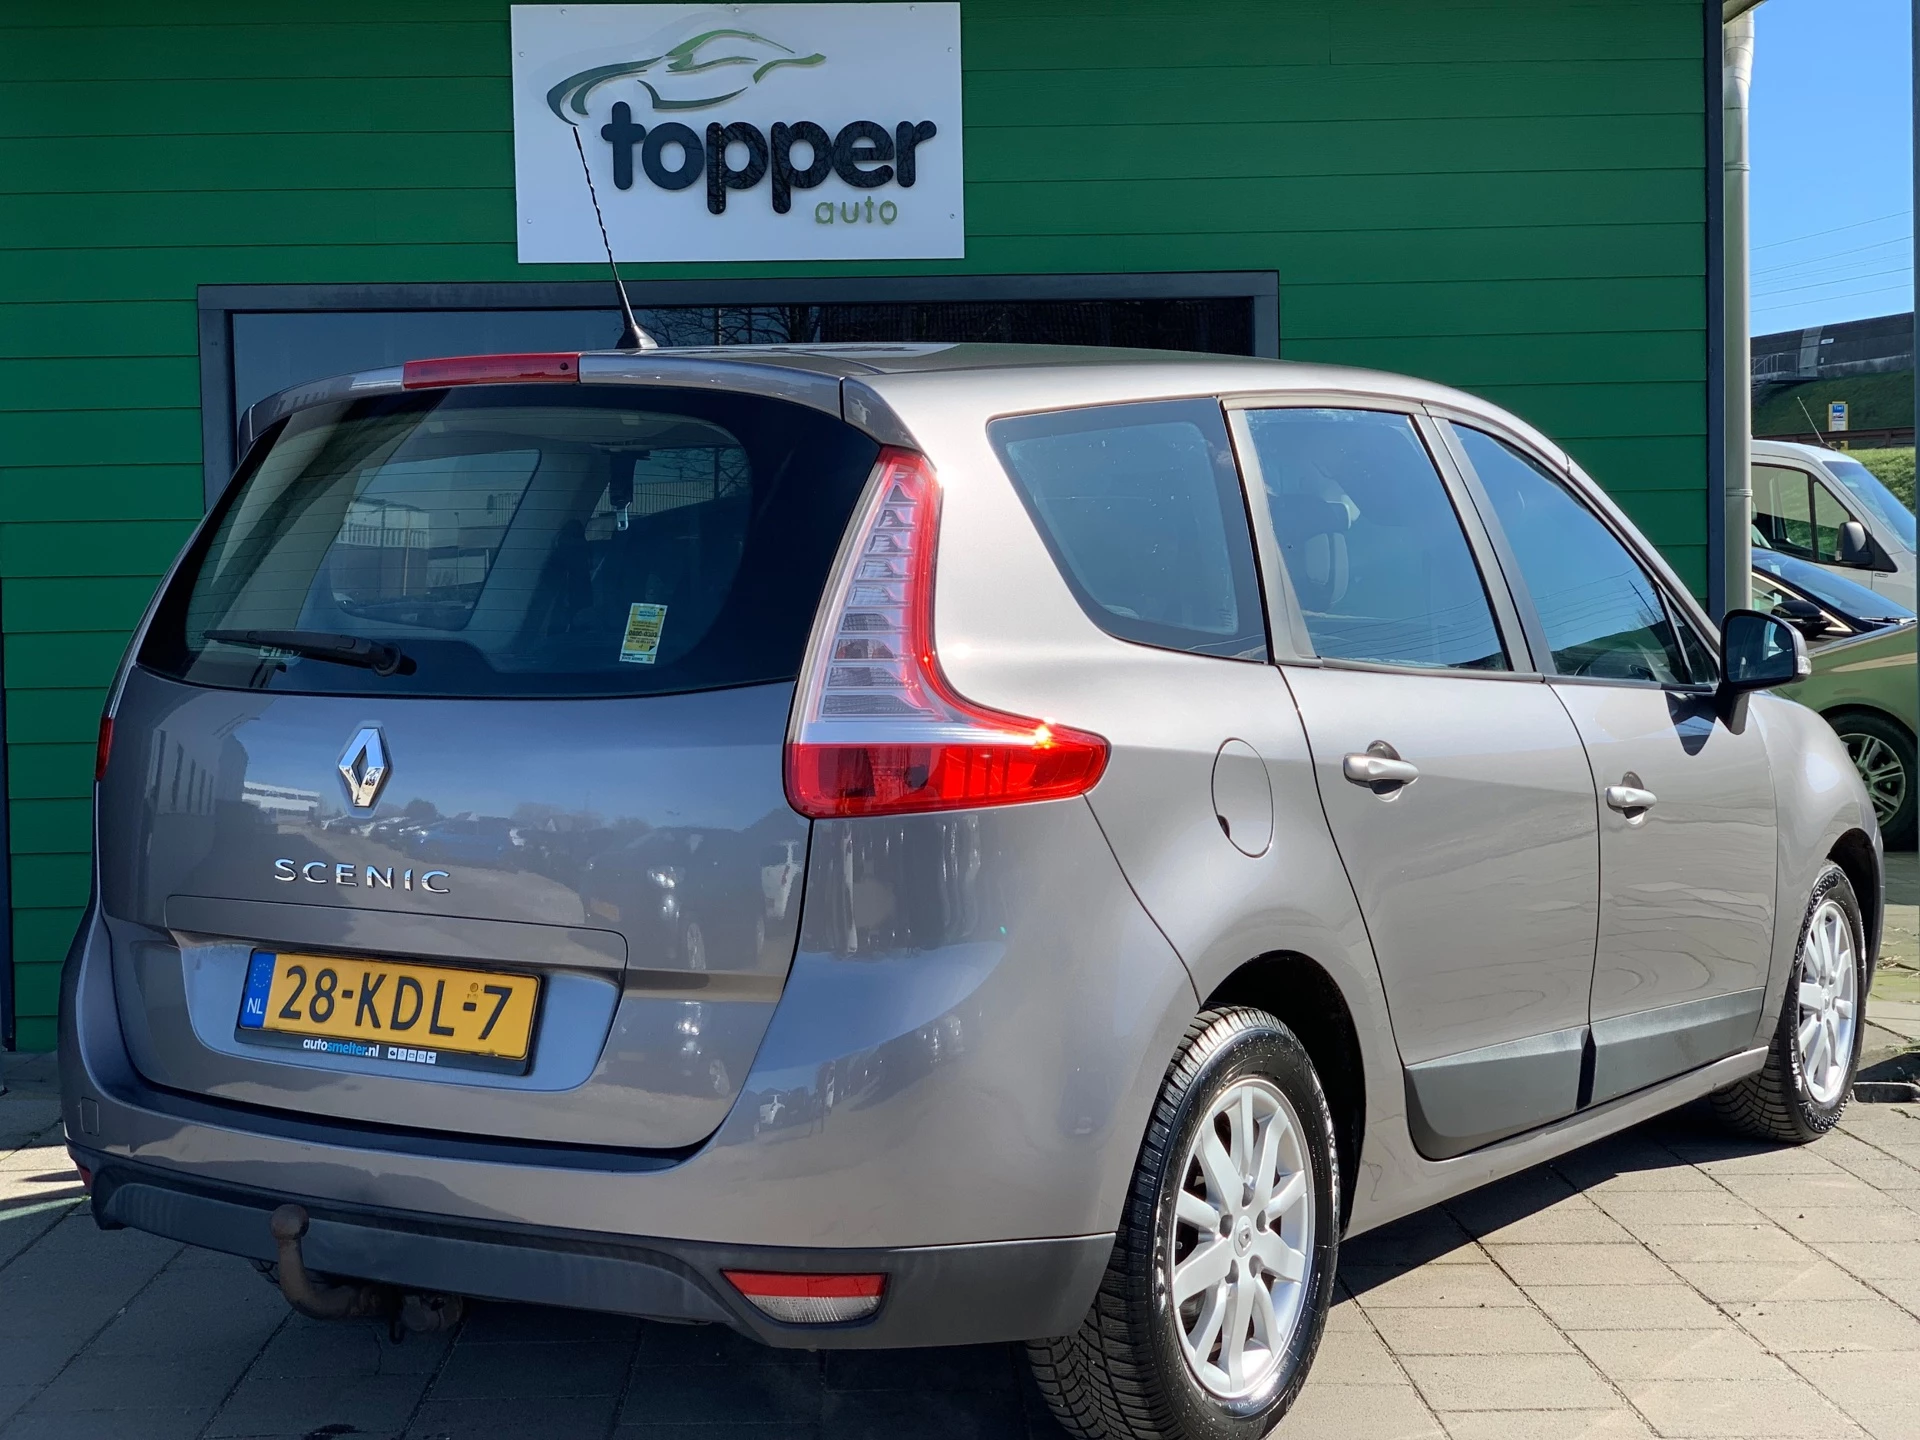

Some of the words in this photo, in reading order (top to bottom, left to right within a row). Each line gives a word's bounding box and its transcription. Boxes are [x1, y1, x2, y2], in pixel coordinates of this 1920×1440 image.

[600, 101, 937, 215] topper
[814, 195, 898, 225] auto
[274, 858, 450, 894] SCENIC
[246, 997, 263, 1015] NL
[279, 965, 513, 1040] 28-KDL-7
[303, 1038, 380, 1057] autosmelter.nl
